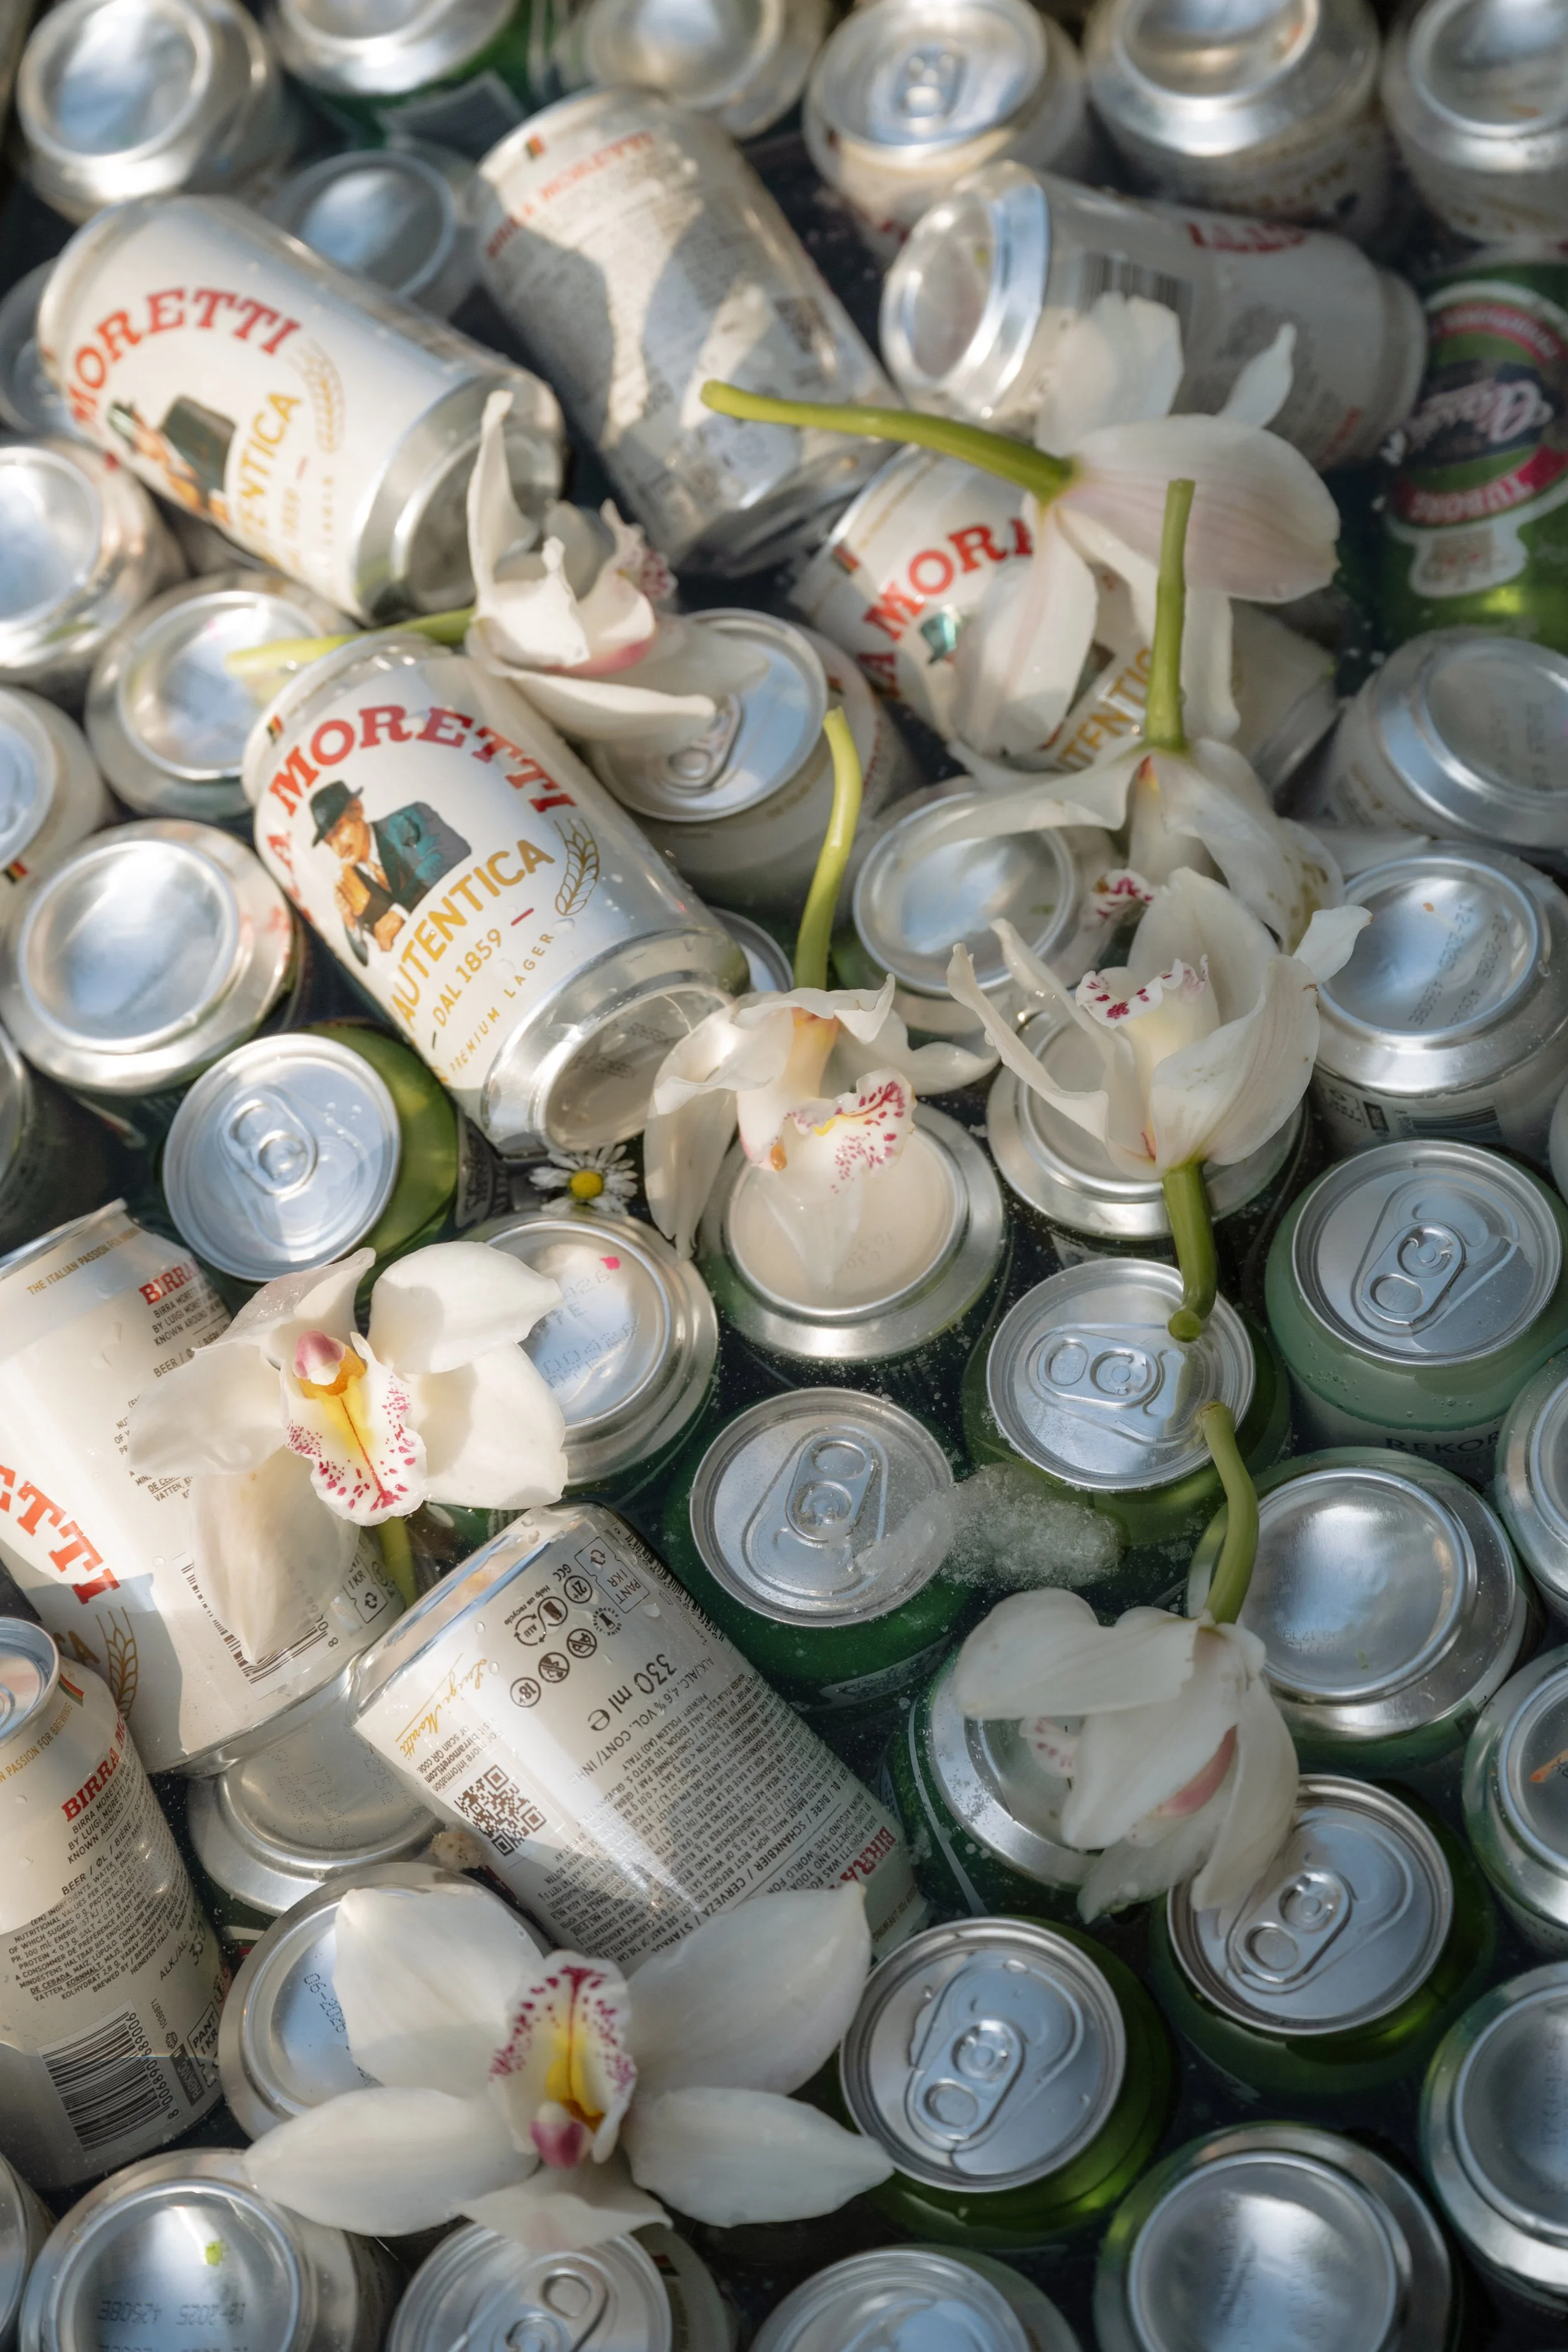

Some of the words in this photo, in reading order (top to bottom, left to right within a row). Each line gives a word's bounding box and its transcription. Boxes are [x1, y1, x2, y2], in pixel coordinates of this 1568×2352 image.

[68, 288, 301, 425] MORETTI
[268, 704, 578, 817] MORETTI
[391, 839, 556, 1031] AUTENTICA
[432, 983, 462, 1027] DAL
[455, 928, 502, 984] 1859
[449, 1007, 501, 1073] PREMIUM
[504, 933, 554, 999] LAGER
[26, 1279, 47, 1296] THE
[46, 1260, 80, 1286] ITALIAN
[78, 1245, 111, 1267] PASSION
[139, 1256, 200, 1306] BIRRA
[152, 1323, 164, 1334] BY
[164, 1310, 186, 1327] LUIGI
[154, 1301, 177, 1319] BIRRA
[153, 1323, 184, 1347] KNOWN
[153, 1358, 179, 1378] BEER
[114, 1433, 124, 1445] OF
[147, 1481, 159, 1493] DE
[154, 1482, 185, 1502] VATTEN,
[353, 1569, 367, 1585] KR
[551, 1561, 573, 1583] GCC
[525, 1596, 536, 1606] us
[534, 1583, 551, 1601] Help
[612, 1577, 642, 1605] PANT
[502, 1602, 528, 1627] recycle
[521, 1623, 539, 1639] ALU
[630, 1651, 679, 1698] 330
[677, 1655, 714, 1693] ALK./ALC.
[606, 1684, 637, 1715] ml
[652, 1698, 666, 1713] %
[662, 1683, 680, 1704] 4,6
[399, 1705, 443, 1762] Moretti
[628, 1705, 657, 1734] VOL.
[655, 1715, 682, 1743] POLLEIN
[688, 1710, 706, 1730] VIALE
[5, 1745, 41, 1777] PASSION
[37, 1730, 55, 1751] FOR
[50, 1703, 75, 1736] BREWING
[440, 1732, 460, 1752] scan
[464, 1740, 488, 1762] more
[595, 1727, 632, 1765] CONT/
[664, 1724, 689, 1751] EDISON,
[694, 1730, 720, 1755] PROTEIN
[720, 1724, 763, 1766] PREFERENTEMENTE
[736, 1736, 768, 1768] DOSENBODEN
[416, 1757, 434, 1776] code.
[423, 1732, 480, 1784] birramoretti.com
[431, 1748, 444, 1763] QR
[621, 1751, 643, 1774] ITALY
[631, 1755, 655, 1780] SESTO
[650, 1735, 695, 1778] CONDITIONNÉE
[56, 1745, 124, 1823] BIRRA
[431, 1758, 468, 1793] information
[690, 1778, 704, 1794] DEL
[701, 1761, 723, 1784] ANTES
[714, 1762, 739, 1787] ENERGIE
[750, 1760, 778, 1789] UDGANGEN
[702, 1782, 718, 1798] PRO
[736, 1788, 766, 1816] MÆTTEDE
[67, 1836, 81, 1851] BY
[80, 1816, 102, 1840] LUIGI
[100, 1784, 128, 1819] MORETTI
[71, 1809, 96, 1835] BIRRA
[95, 1778, 123, 1813] MORETTI
[66, 1834, 101, 1865] KNOWN
[97, 1802, 125, 1837] AROUND
[707, 1812, 739, 1843] FEDSYRER
[828, 1808, 853, 1837] AROUND
[733, 1850, 753, 1870] BEST
[751, 1819, 808, 1872] SCHANKBIER
[812, 1850, 831, 1870] AND
[701, 1858, 726, 1882] WHICH
[784, 1848, 816, 1879] WORLD
[821, 1857, 841, 1879] WAS
[60, 1872, 88, 1897] BEER
[707, 1865, 734, 1893] BEFORE
[788, 1868, 814, 1892] TODA
[47, 1882, 93, 1917] INGREDIENTS:
[699, 1875, 747, 1919] CERVEZA
[13, 1915, 61, 1942] NUTRITIONAL
[61, 1897, 87, 1918] VALUES
[17, 1952, 51, 1970] PROTEIN
[78, 1922, 97, 1939] SALT
[119, 1884, 138, 1904] BEDST
[19, 1934, 46, 1950] WHICH
[46, 1917, 75, 1937] SUGARS
[88, 1885, 114, 1909] PROTEIN
[117, 1911, 146, 1941] CONSUMIR
[21, 1952, 67, 1979] CONSOMMER
[66, 1946, 78, 1957] DE
[77, 1917, 116, 1950] PRÉFÉRENCE
[115, 1901, 135, 1921] AVANT
[52, 1925, 79, 1943] ENERGI
[18, 1965, 63, 1989] MINDESTENS
[62, 1946, 95, 1968] HALTBAR
[60, 1973, 103, 2000] KOLHYDRAT
[120, 1942, 140, 1961] VARAV
[92, 1969, 120, 1994] BREWED
[119, 1962, 129, 1973] BY
[134, 1933, 158, 1960] BRYGGET
[129, 1946, 157, 1976] HEINEKEN
[33, 1984, 65, 2001] VATTEN,
[151, 1998, 168, 2030] 1039871
[125, 2012, 152, 2057] 689006
[192, 2010, 216, 2048] PANT
[205, 2029, 219, 2049] KR
[146, 2060, 174, 2106] 006890
[167, 2109, 179, 2119] 8
